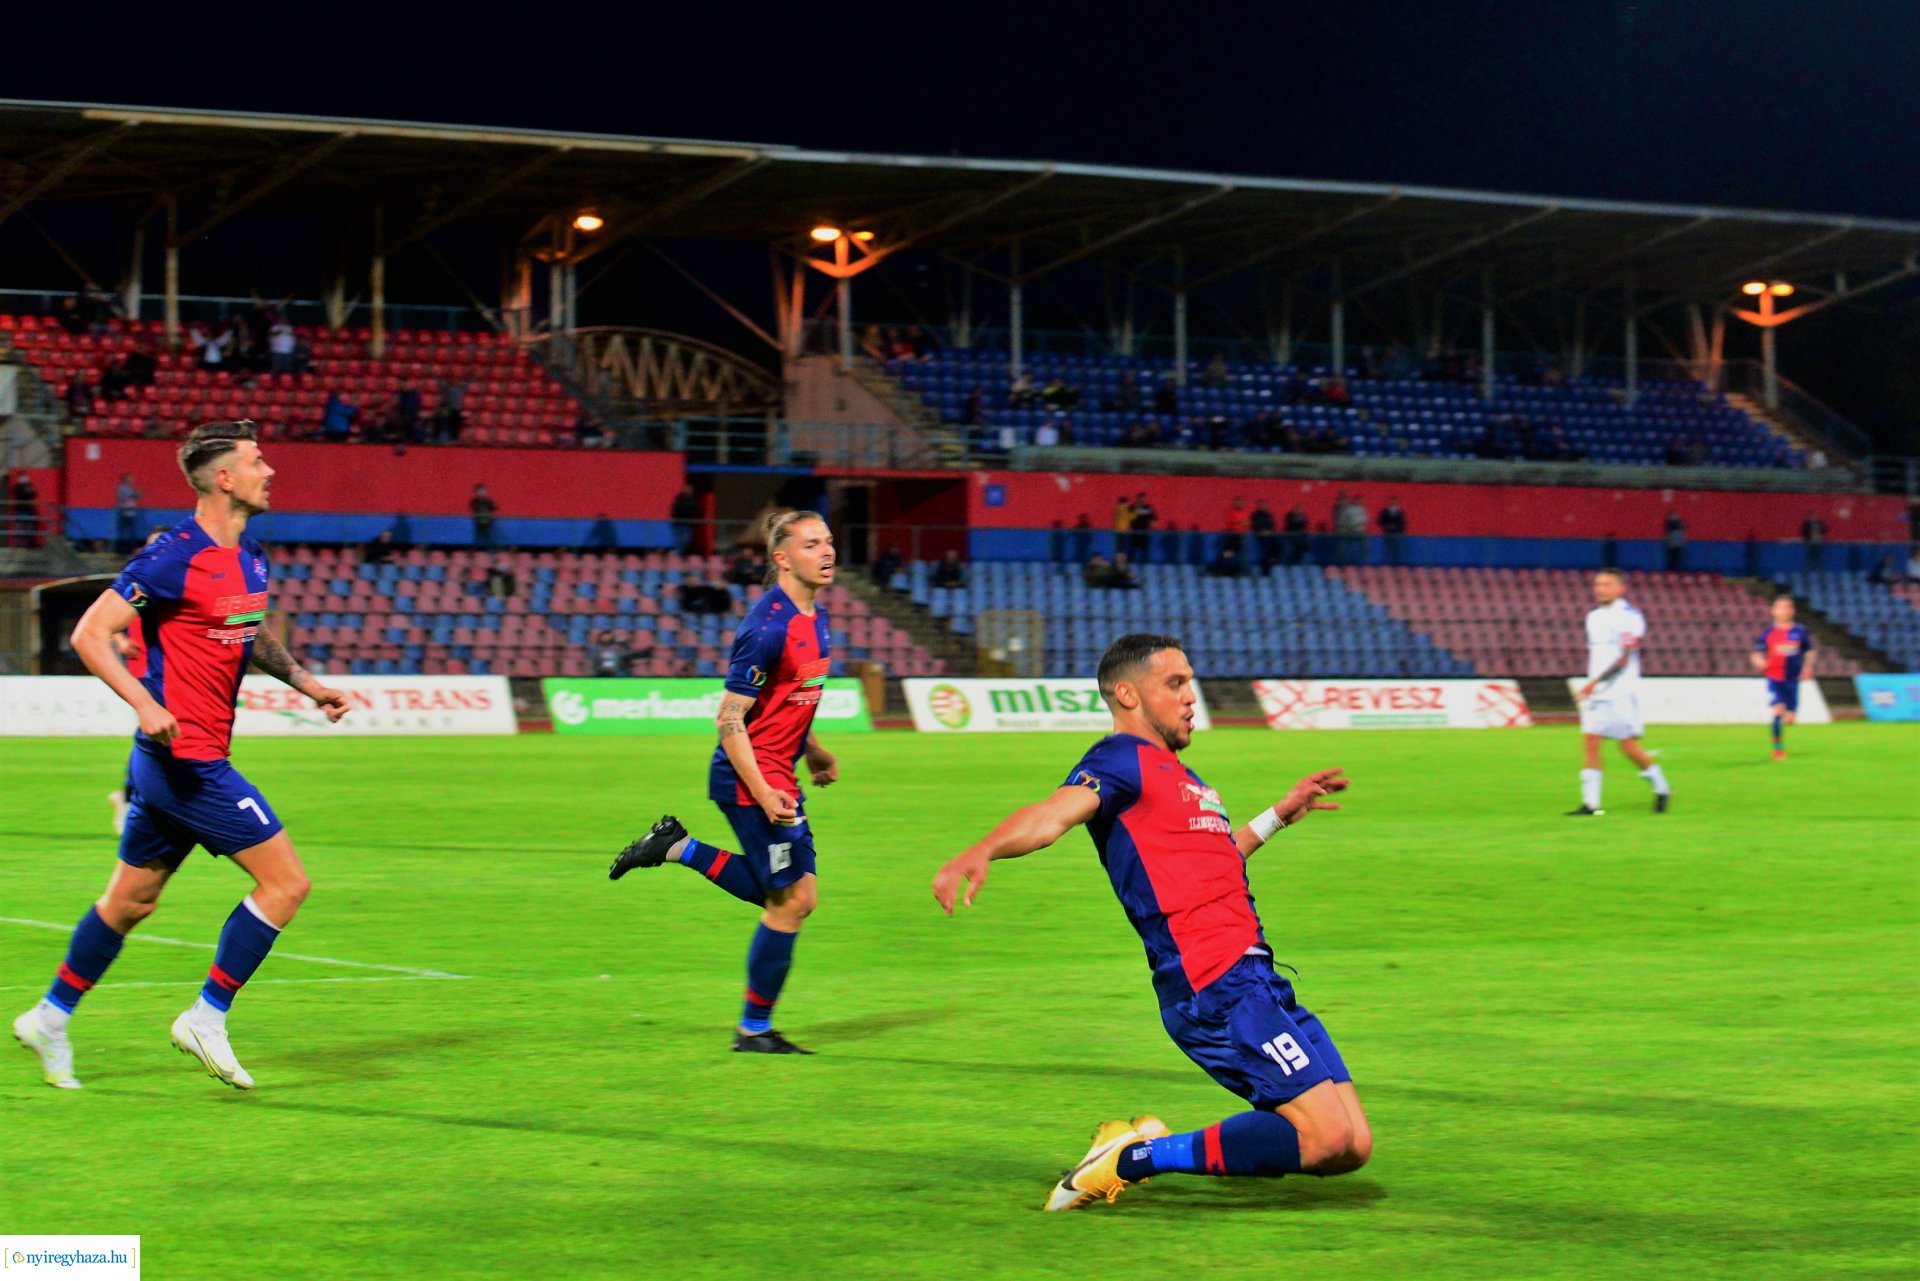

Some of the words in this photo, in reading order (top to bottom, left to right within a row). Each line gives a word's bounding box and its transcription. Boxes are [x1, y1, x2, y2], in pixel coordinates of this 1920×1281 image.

[384, 688, 492, 711] TRANS
[236, 797, 270, 825] 7
[1261, 1032, 1310, 1076] 19
